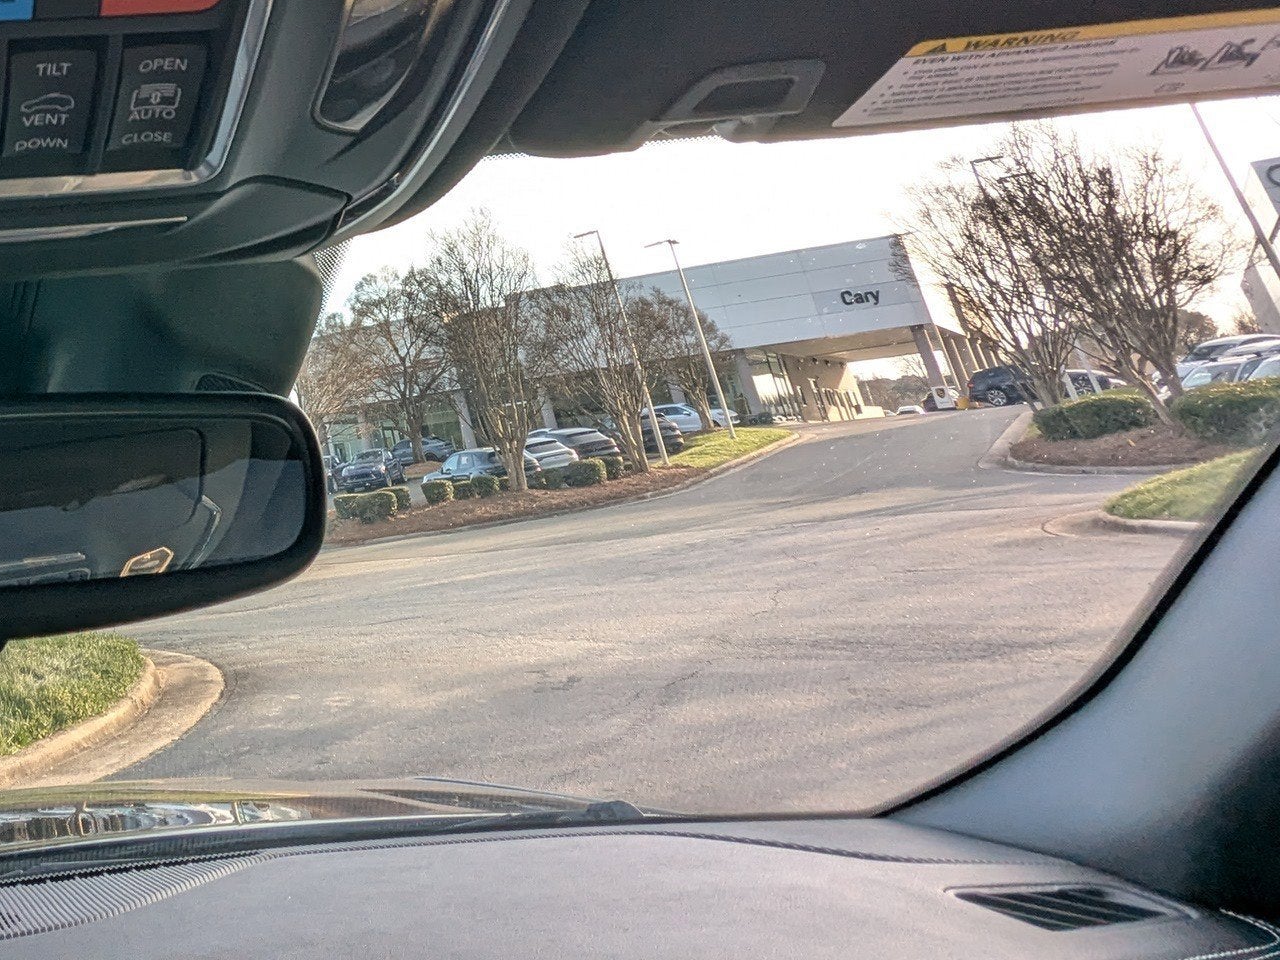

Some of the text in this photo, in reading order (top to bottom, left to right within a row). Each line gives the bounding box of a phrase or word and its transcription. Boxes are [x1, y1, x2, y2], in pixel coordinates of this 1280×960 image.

[35, 62, 73, 77] TILT
[138, 58, 189, 73] OPEN
[22, 113, 68, 127] VENT
[128, 107, 177, 121] AUTO
[15, 136, 69, 152] DOWN
[121, 130, 173, 146] CLOSE
[840, 290, 880, 306] Cary
